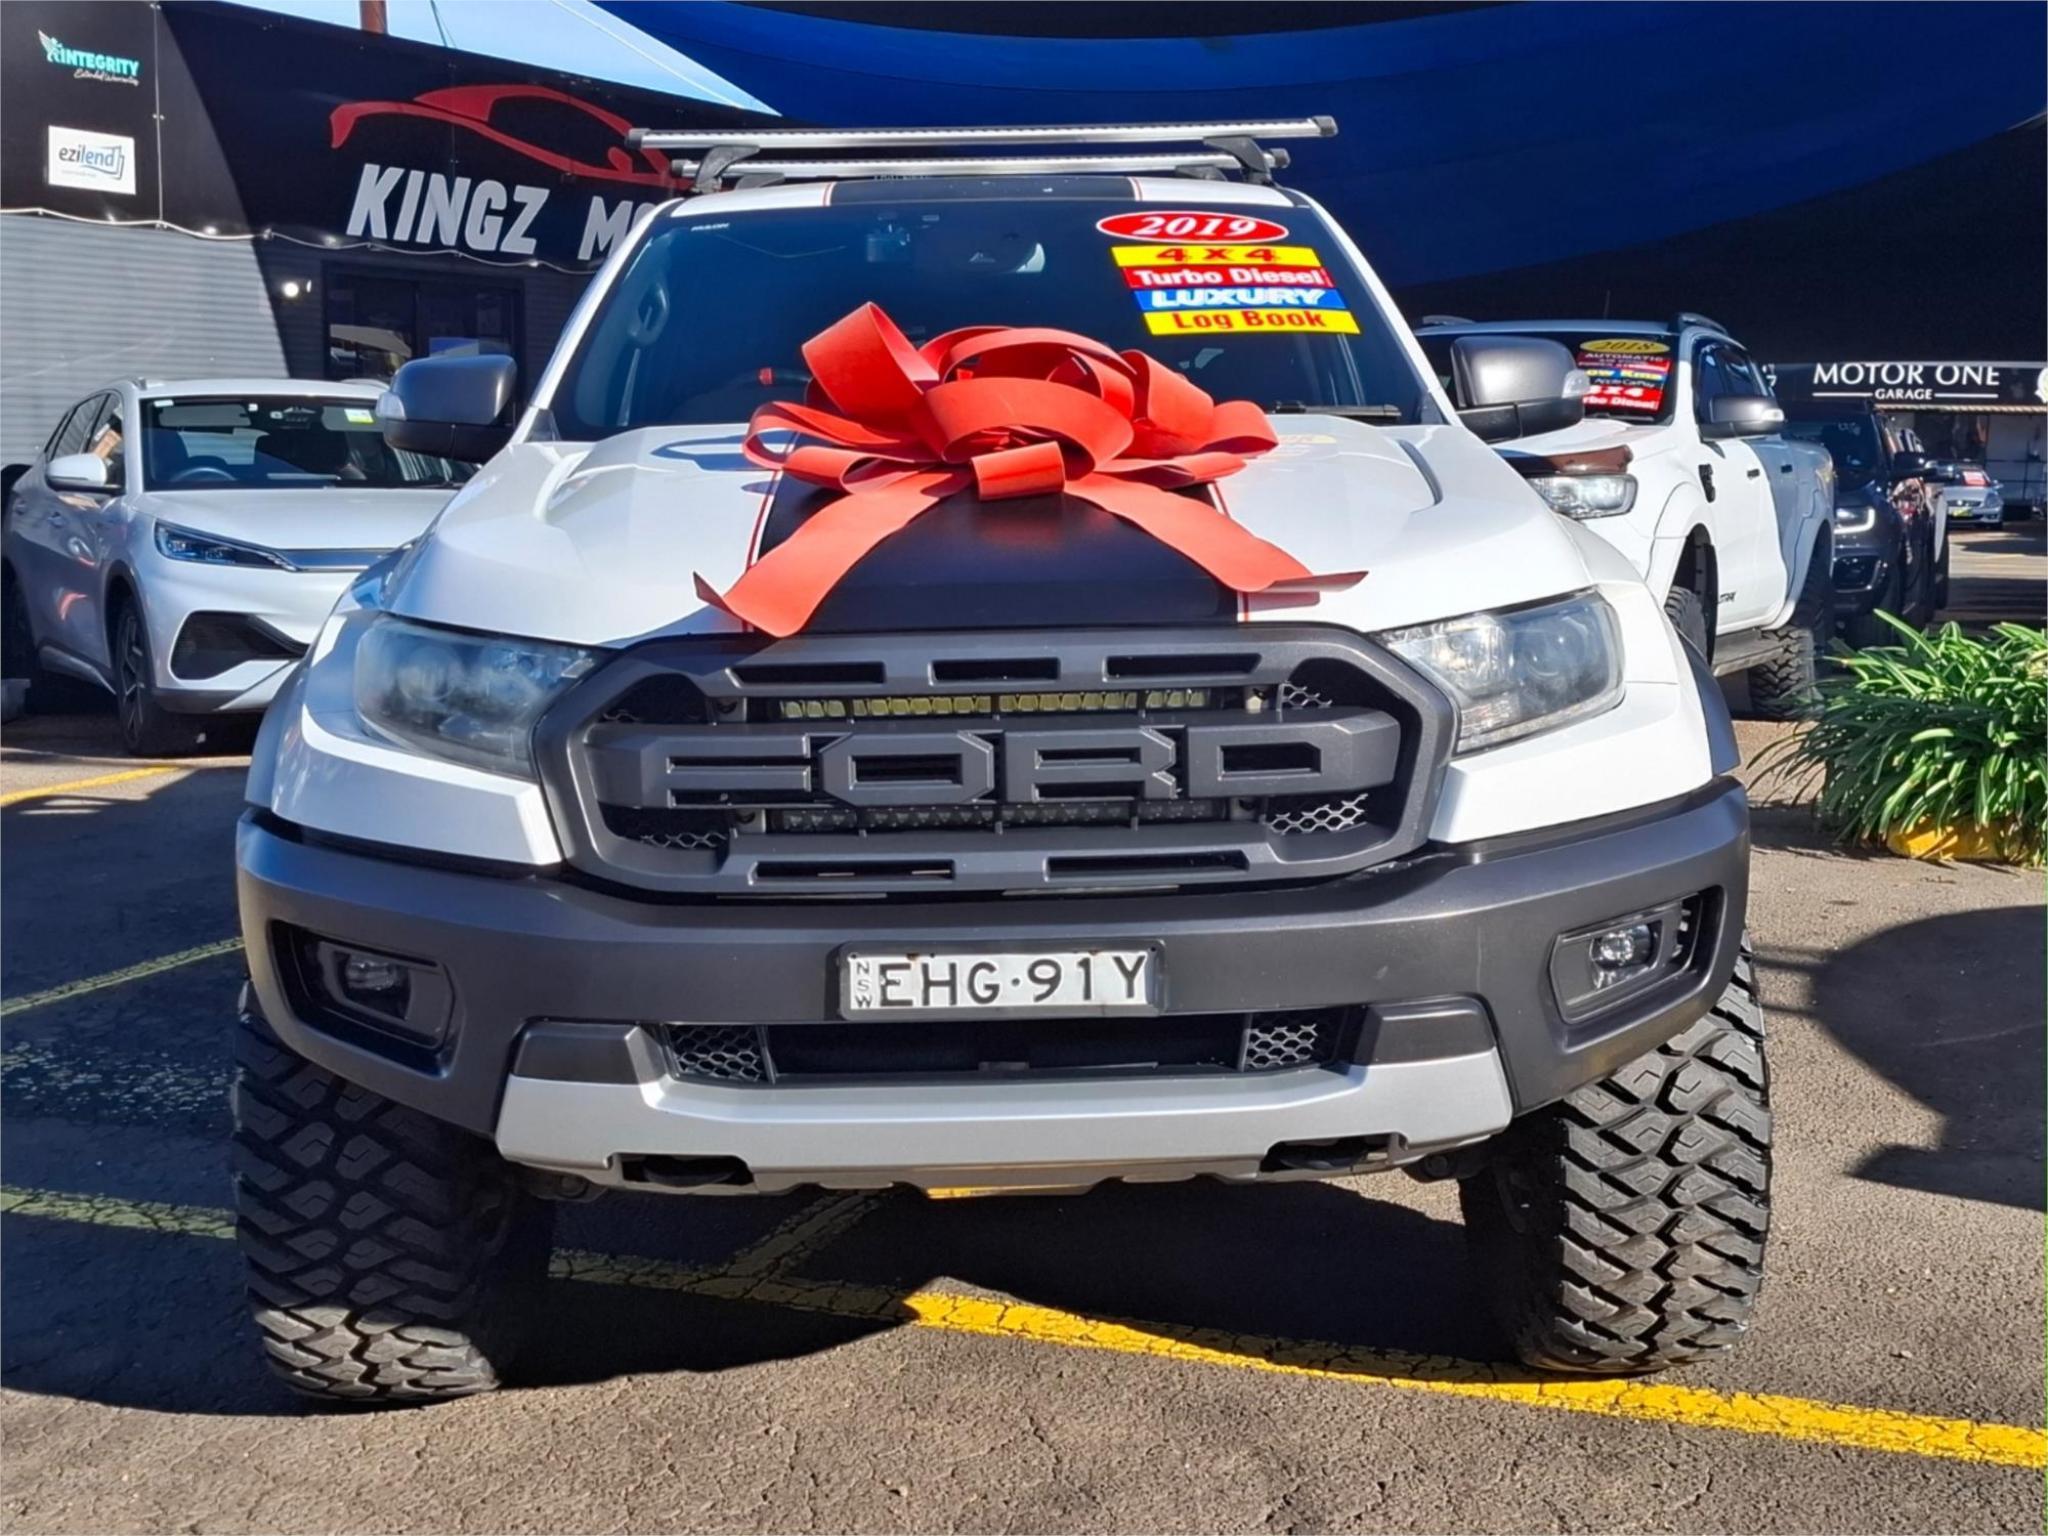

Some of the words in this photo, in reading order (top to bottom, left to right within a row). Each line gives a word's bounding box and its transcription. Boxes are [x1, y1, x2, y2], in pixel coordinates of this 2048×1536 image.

[60, 46, 139, 77] INTEGRITY
[58, 144, 116, 167] ezilend
[346, 162, 550, 255] KINGZ
[1131, 216, 1258, 237] 2019
[1132, 267, 1224, 286] Turbo
[1229, 267, 1326, 286] Diesel
[1150, 287, 1327, 308] LUXURY
[1172, 313, 1234, 330] Log
[1241, 310, 1327, 328] Book
[1585, 353, 1664, 362] AUTOMATIC
[1813, 362, 1924, 385] MOTOR
[1935, 363, 2000, 386] ONE
[1874, 388, 1933, 400] GARAGE
[592, 722, 1400, 808] FORD
